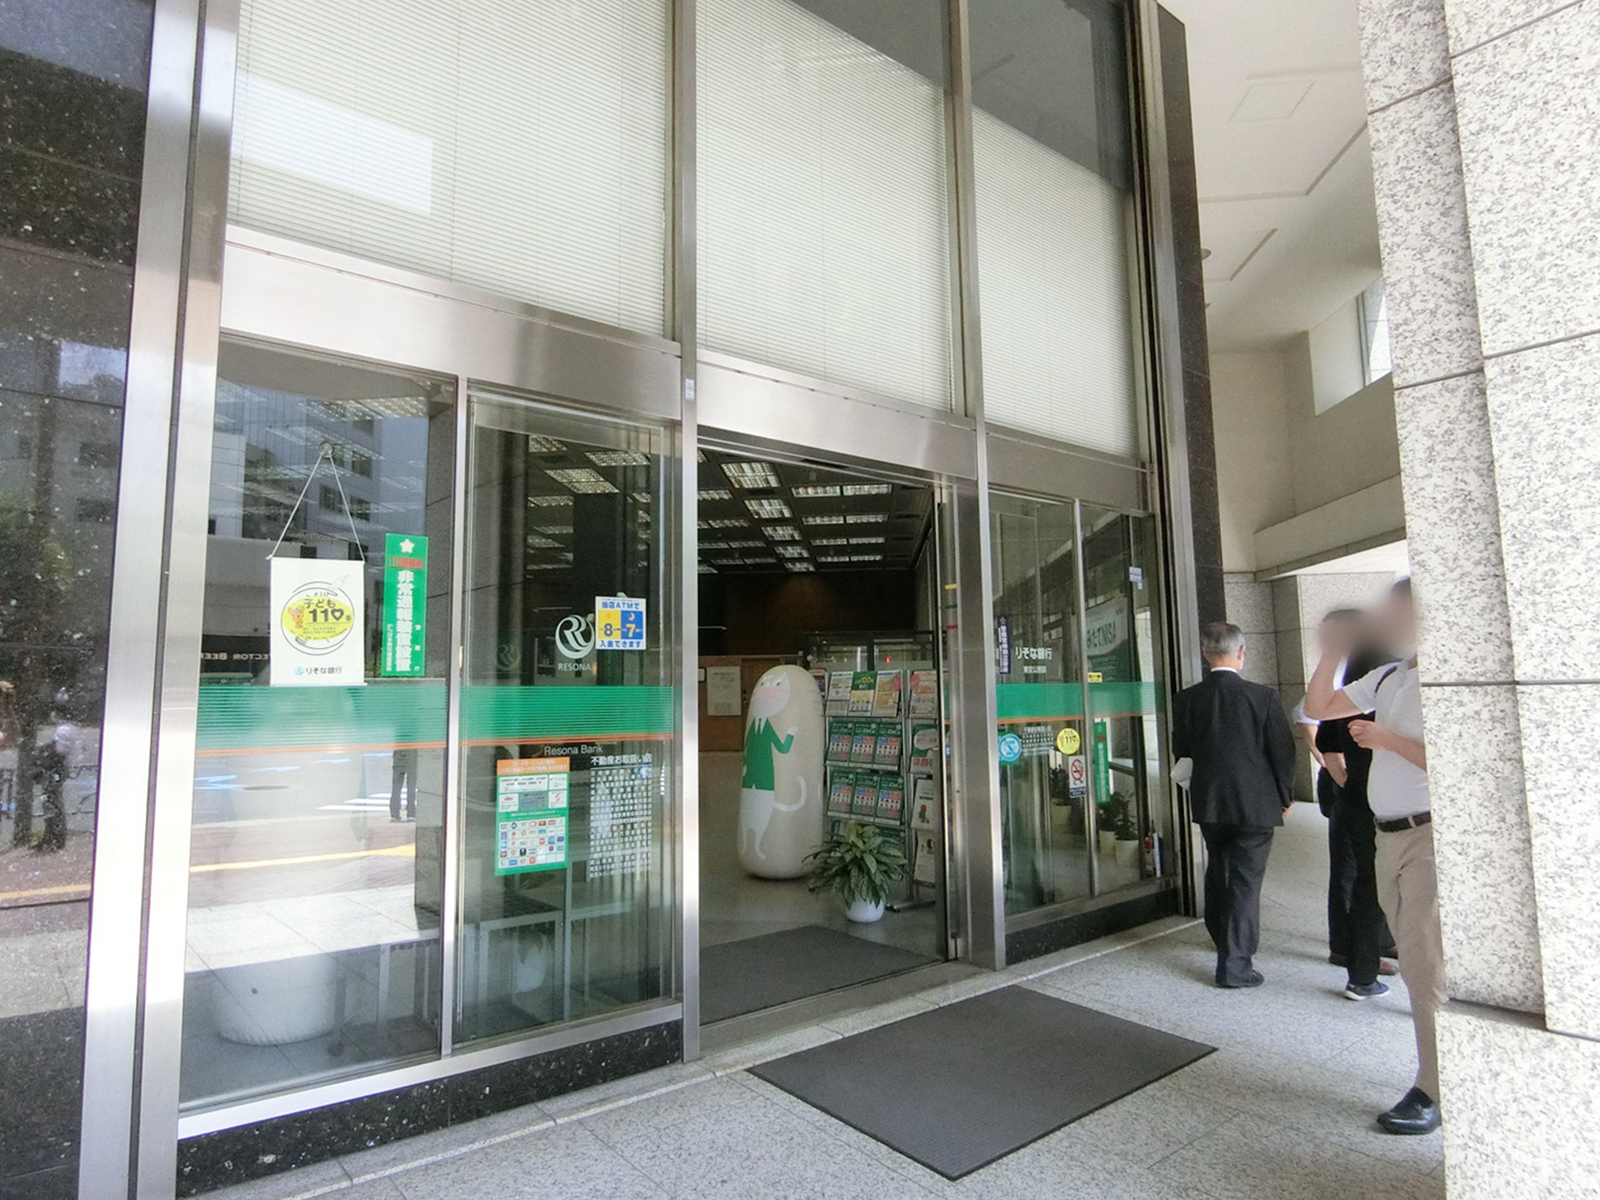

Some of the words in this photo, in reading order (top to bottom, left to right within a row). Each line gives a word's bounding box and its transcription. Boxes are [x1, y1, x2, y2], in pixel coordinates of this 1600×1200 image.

[303, 599, 336, 609] 子ども
[600, 640, 641, 648] 入金できます
[1015, 647, 1052, 660] りそな銀行
[306, 666, 342, 675] りそな銀行
[557, 662, 592, 671] RESONA
[544, 746, 579, 756] Resona
[580, 744, 603, 754] Bank
